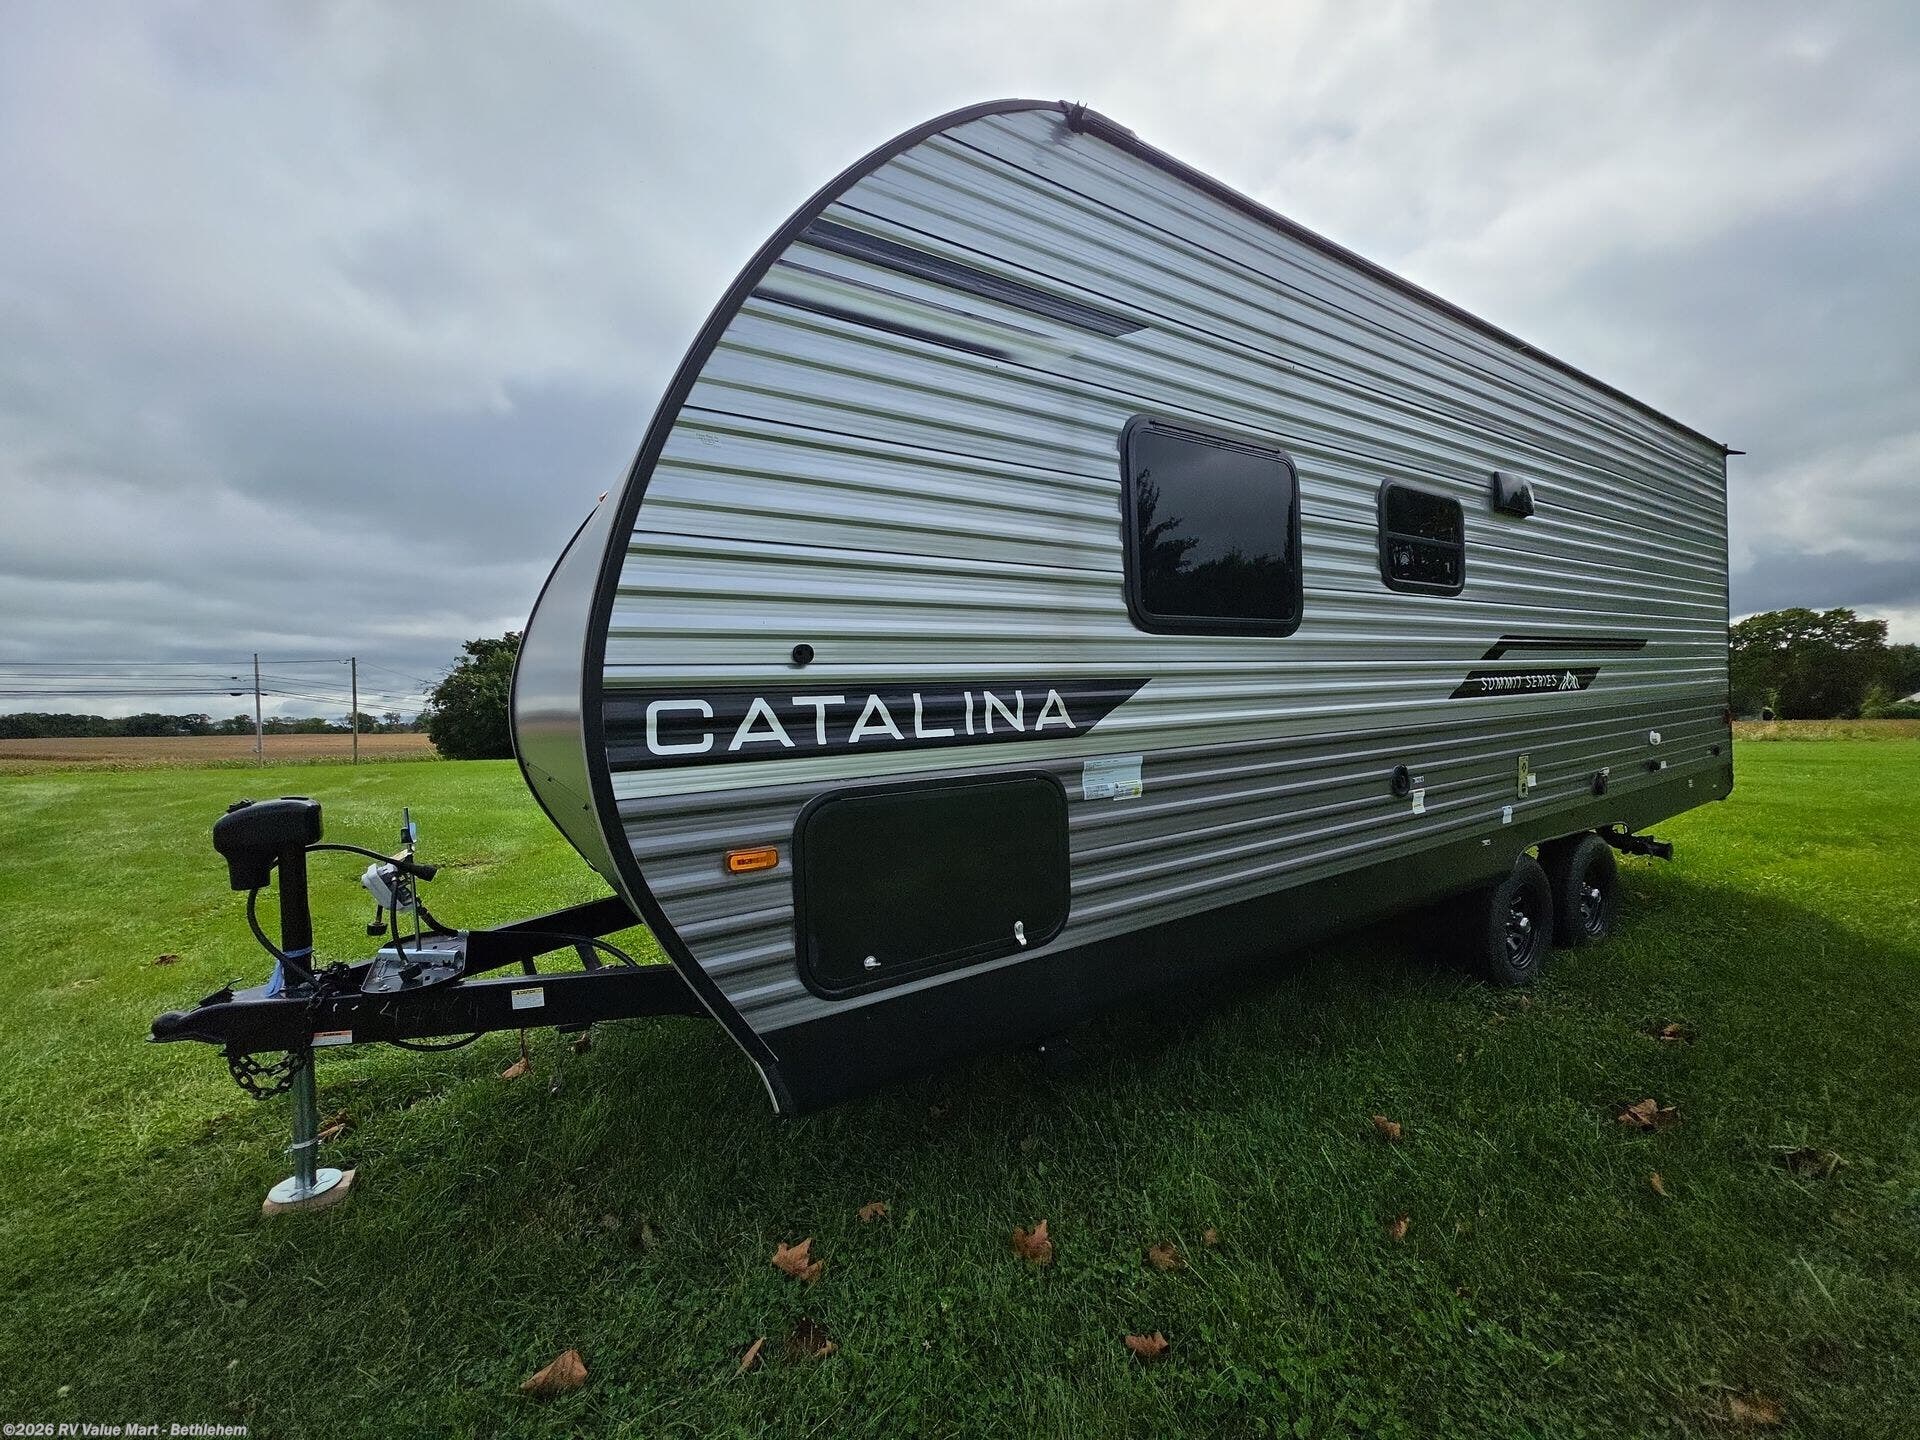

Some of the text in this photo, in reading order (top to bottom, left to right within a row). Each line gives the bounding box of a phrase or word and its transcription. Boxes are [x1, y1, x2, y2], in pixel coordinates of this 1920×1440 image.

[1480, 674, 1557, 691] SUMMIT SERIES
[645, 688, 1077, 756] CATALINA
